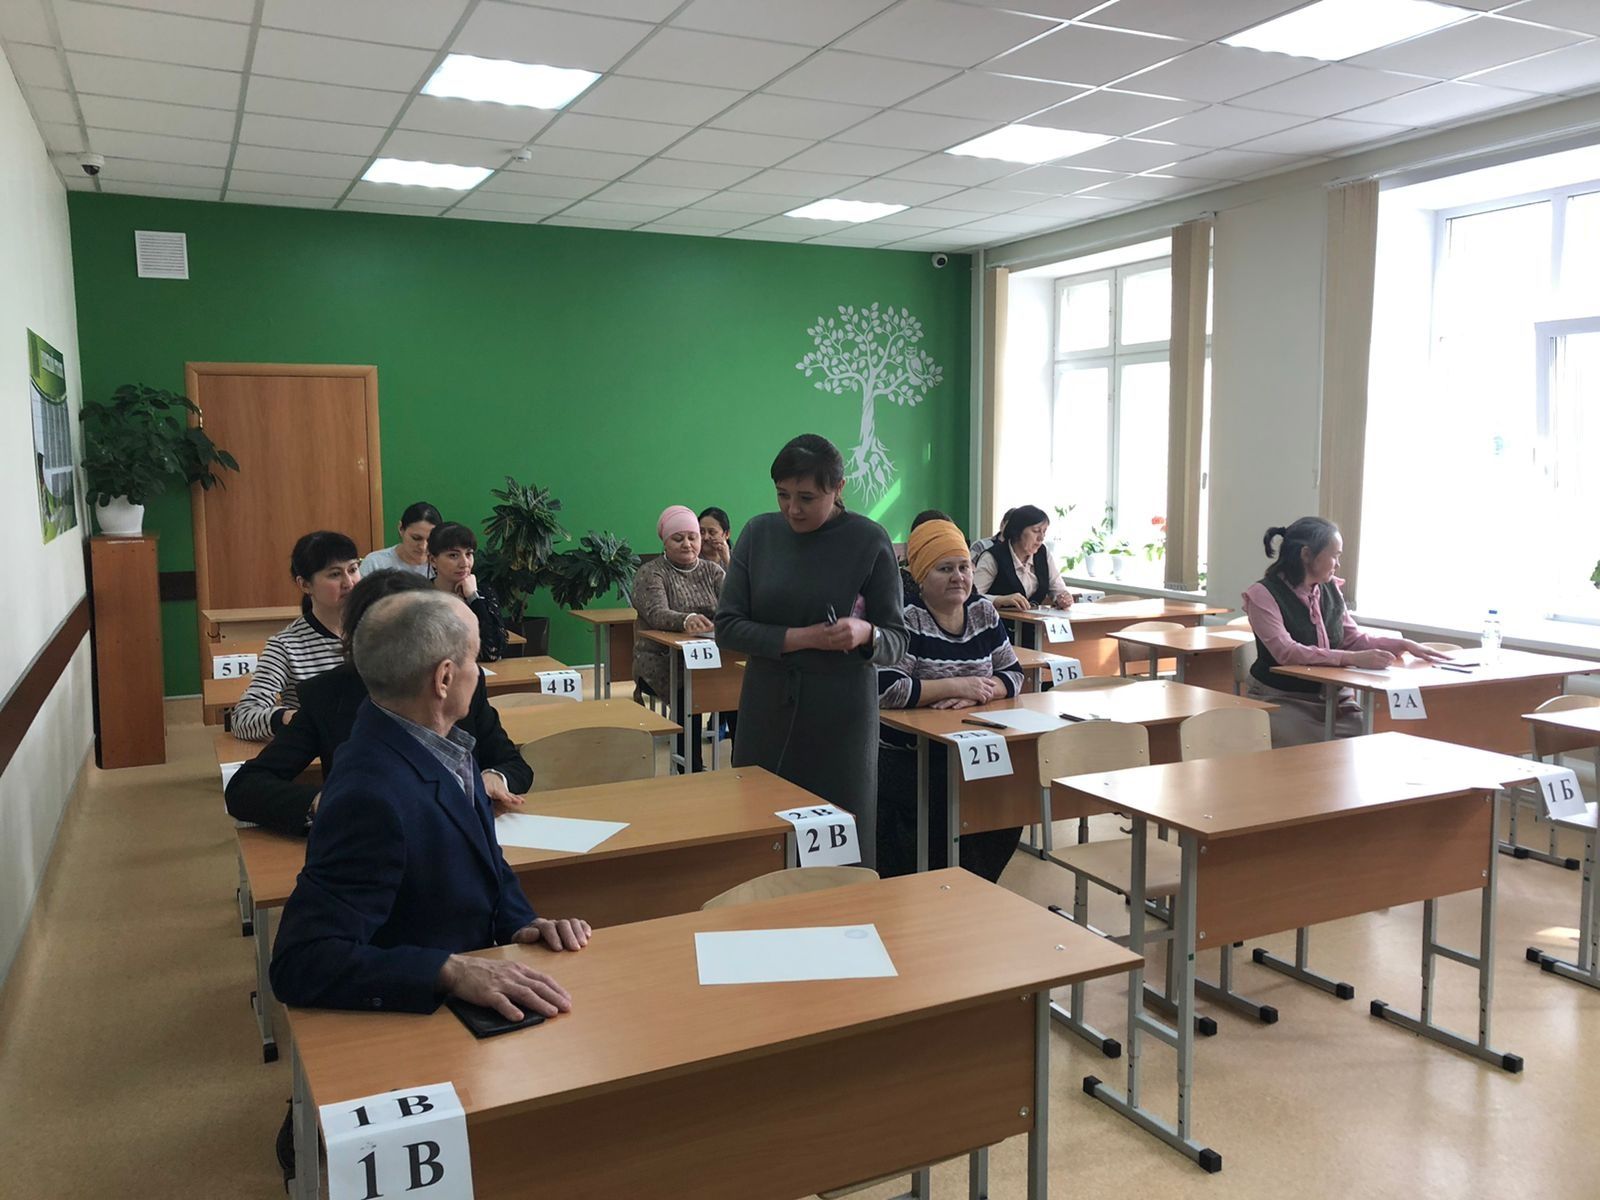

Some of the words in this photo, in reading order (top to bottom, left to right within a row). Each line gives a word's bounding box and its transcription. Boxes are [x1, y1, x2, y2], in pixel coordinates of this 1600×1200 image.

[1050, 624, 1056, 634] 4
[690, 648, 698, 660] 4
[702, 647, 713, 660] Б
[222, 662, 232, 676] 5
[238, 661, 250, 675] В
[1056, 667, 1064, 682] 3
[1067, 665, 1078, 680] Б
[547, 679, 557, 693] 4
[563, 678, 576, 693] В
[1393, 692, 1401, 708] 2
[1405, 693, 1418, 708] А
[968, 746, 980, 765] 2
[985, 743, 1000, 763] Б
[1548, 782, 1556, 803] 1
[1560, 778, 1574, 800] Б
[806, 828, 820, 853] 2
[828, 824, 848, 849] В
[349, 1105, 376, 1128] 1
[393, 1094, 434, 1118] В
[357, 1151, 384, 1200] 1
[402, 1140, 445, 1191] В
